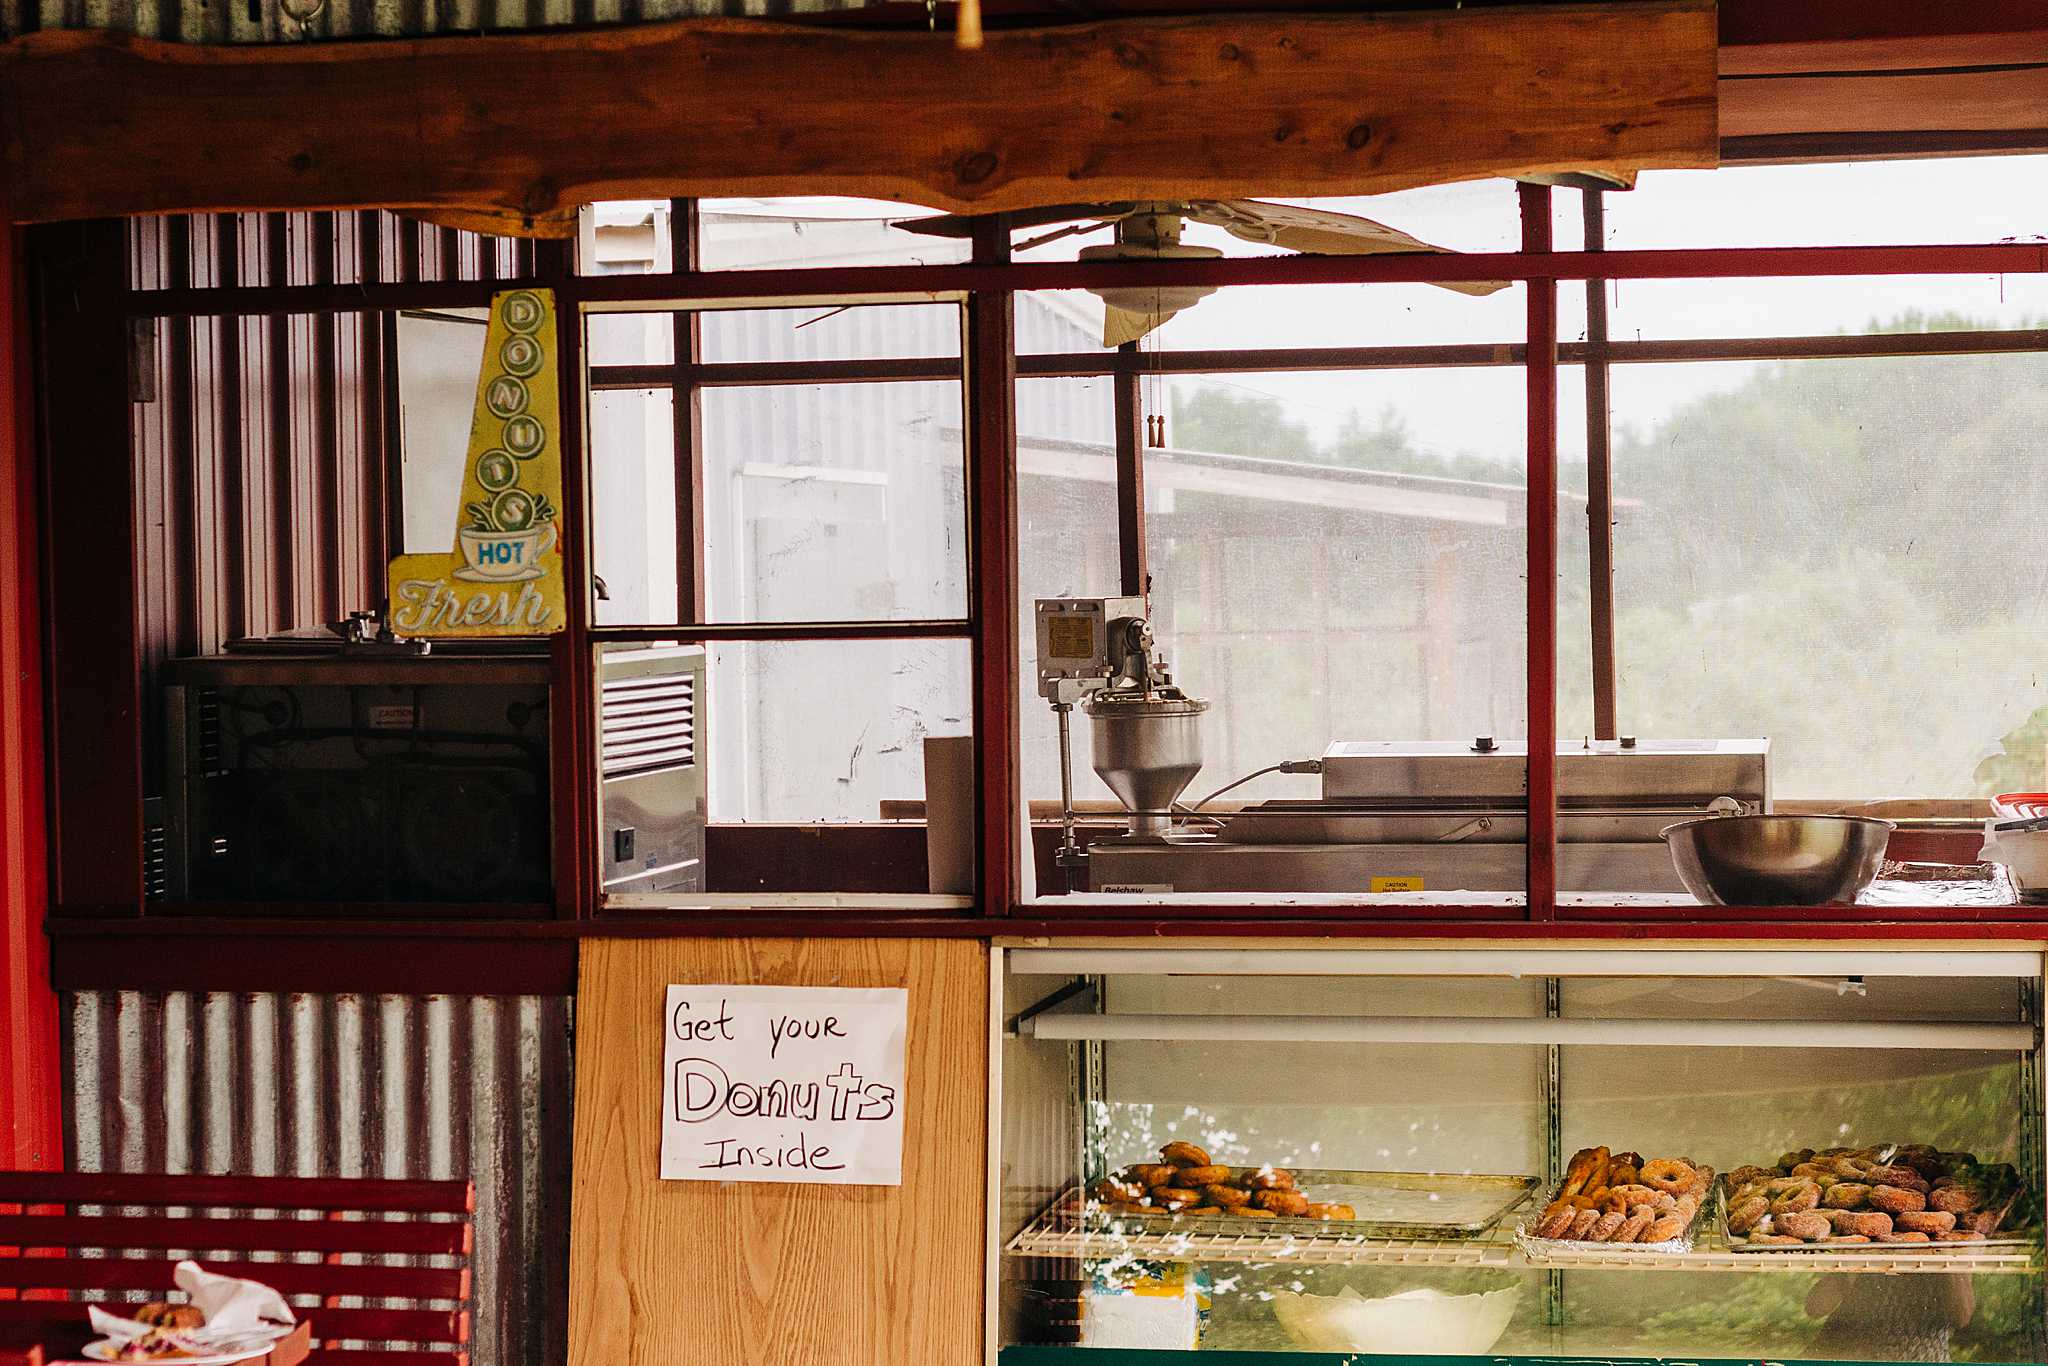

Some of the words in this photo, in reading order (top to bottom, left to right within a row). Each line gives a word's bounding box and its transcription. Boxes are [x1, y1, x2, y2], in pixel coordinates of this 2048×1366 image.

[482, 295, 541, 525] DONUTS
[478, 541, 525, 565] HOT
[396, 580, 550, 630] Fresh
[673, 999, 735, 1041] Get
[674, 1057, 895, 1123] Donuts
[698, 1131, 846, 1170] Inside
